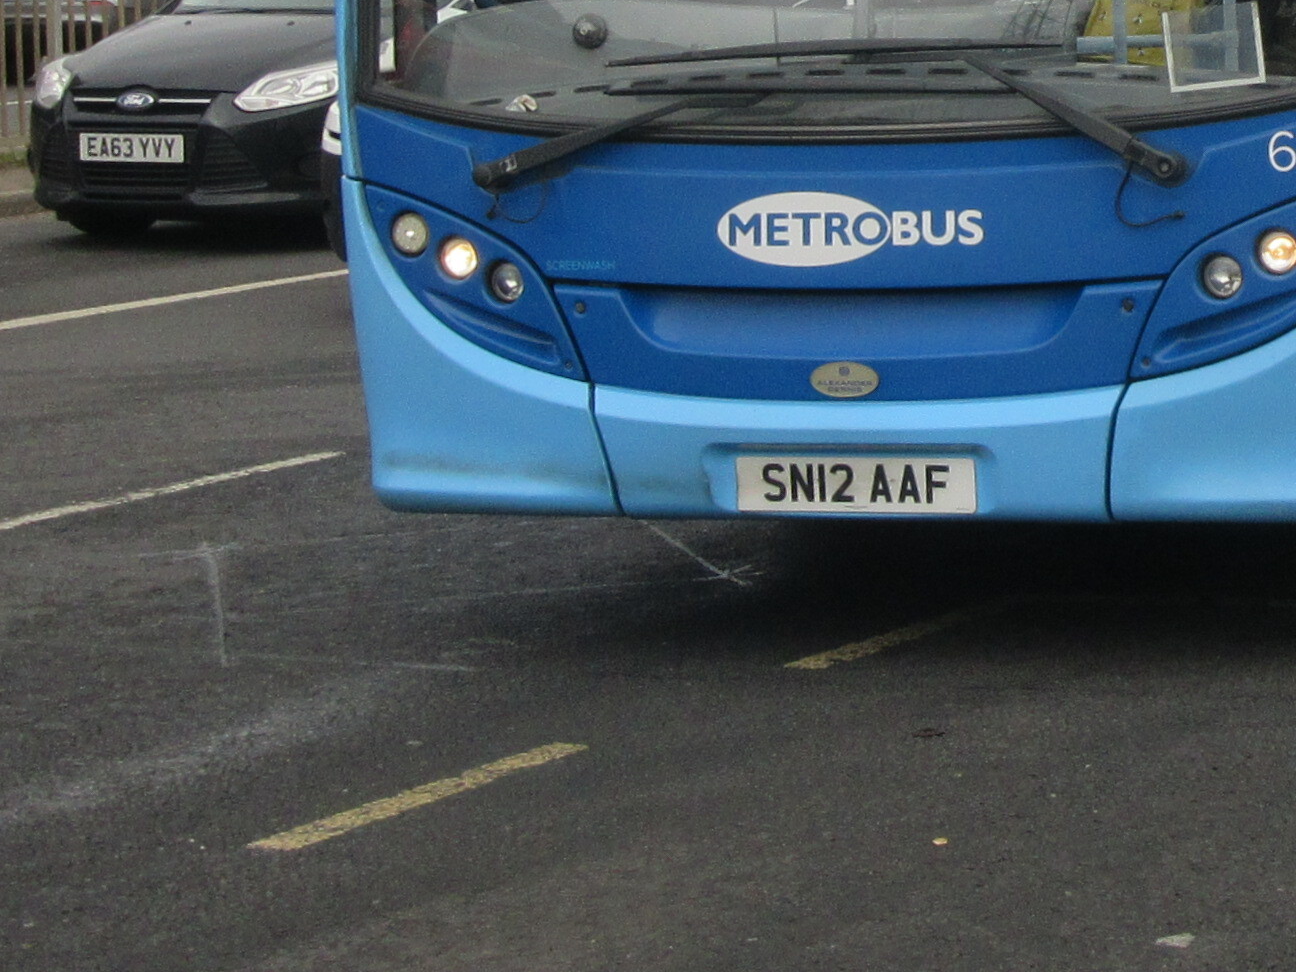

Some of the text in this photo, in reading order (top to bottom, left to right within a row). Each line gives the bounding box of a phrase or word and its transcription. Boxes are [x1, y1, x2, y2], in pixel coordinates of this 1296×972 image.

[87, 136, 175, 159] EA63 YVY
[726, 209, 984, 247] METROBUS
[761, 463, 950, 505] SN12 AAF
